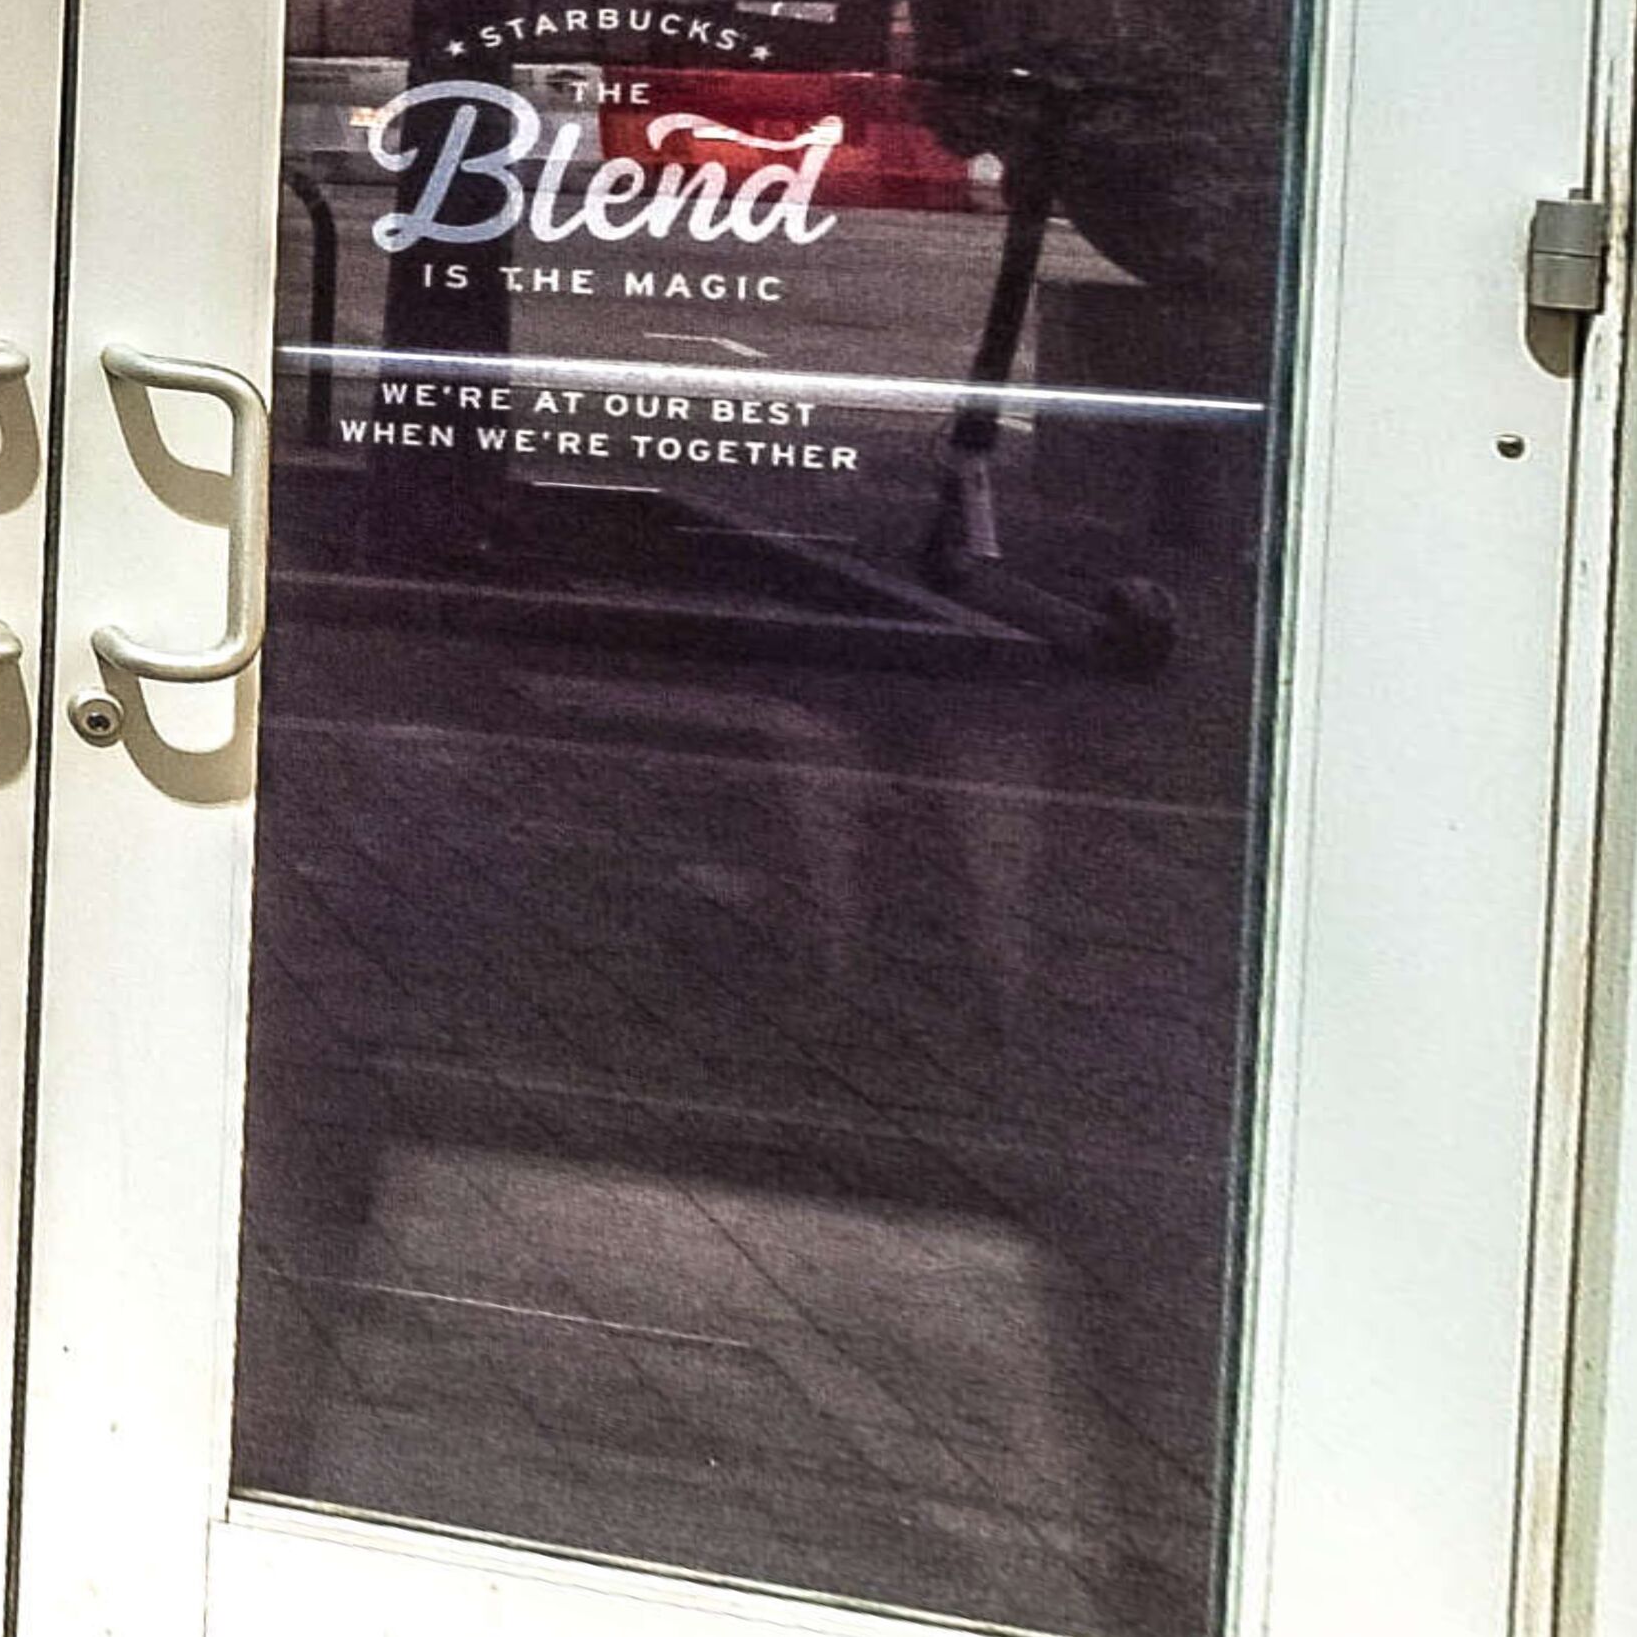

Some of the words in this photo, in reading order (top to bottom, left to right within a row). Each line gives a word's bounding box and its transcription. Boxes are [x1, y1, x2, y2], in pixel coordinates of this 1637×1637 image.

[479, 8, 744, 51] STARBUCKS
[569, 81, 651, 106] THE
[367, 79, 845, 252] Blend
[423, 264, 469, 289] IS
[499, 265, 594, 295] THE
[625, 272, 785, 301] MAGIC
[382, 382, 513, 411] WE'RE
[534, 390, 580, 415] AT
[605, 394, 690, 421] OUR
[712, 399, 816, 427] BEST
[340, 419, 455, 448] WHEN
[477, 428, 610, 456] WE'RE
[631, 434, 858, 470] TOGETHER
